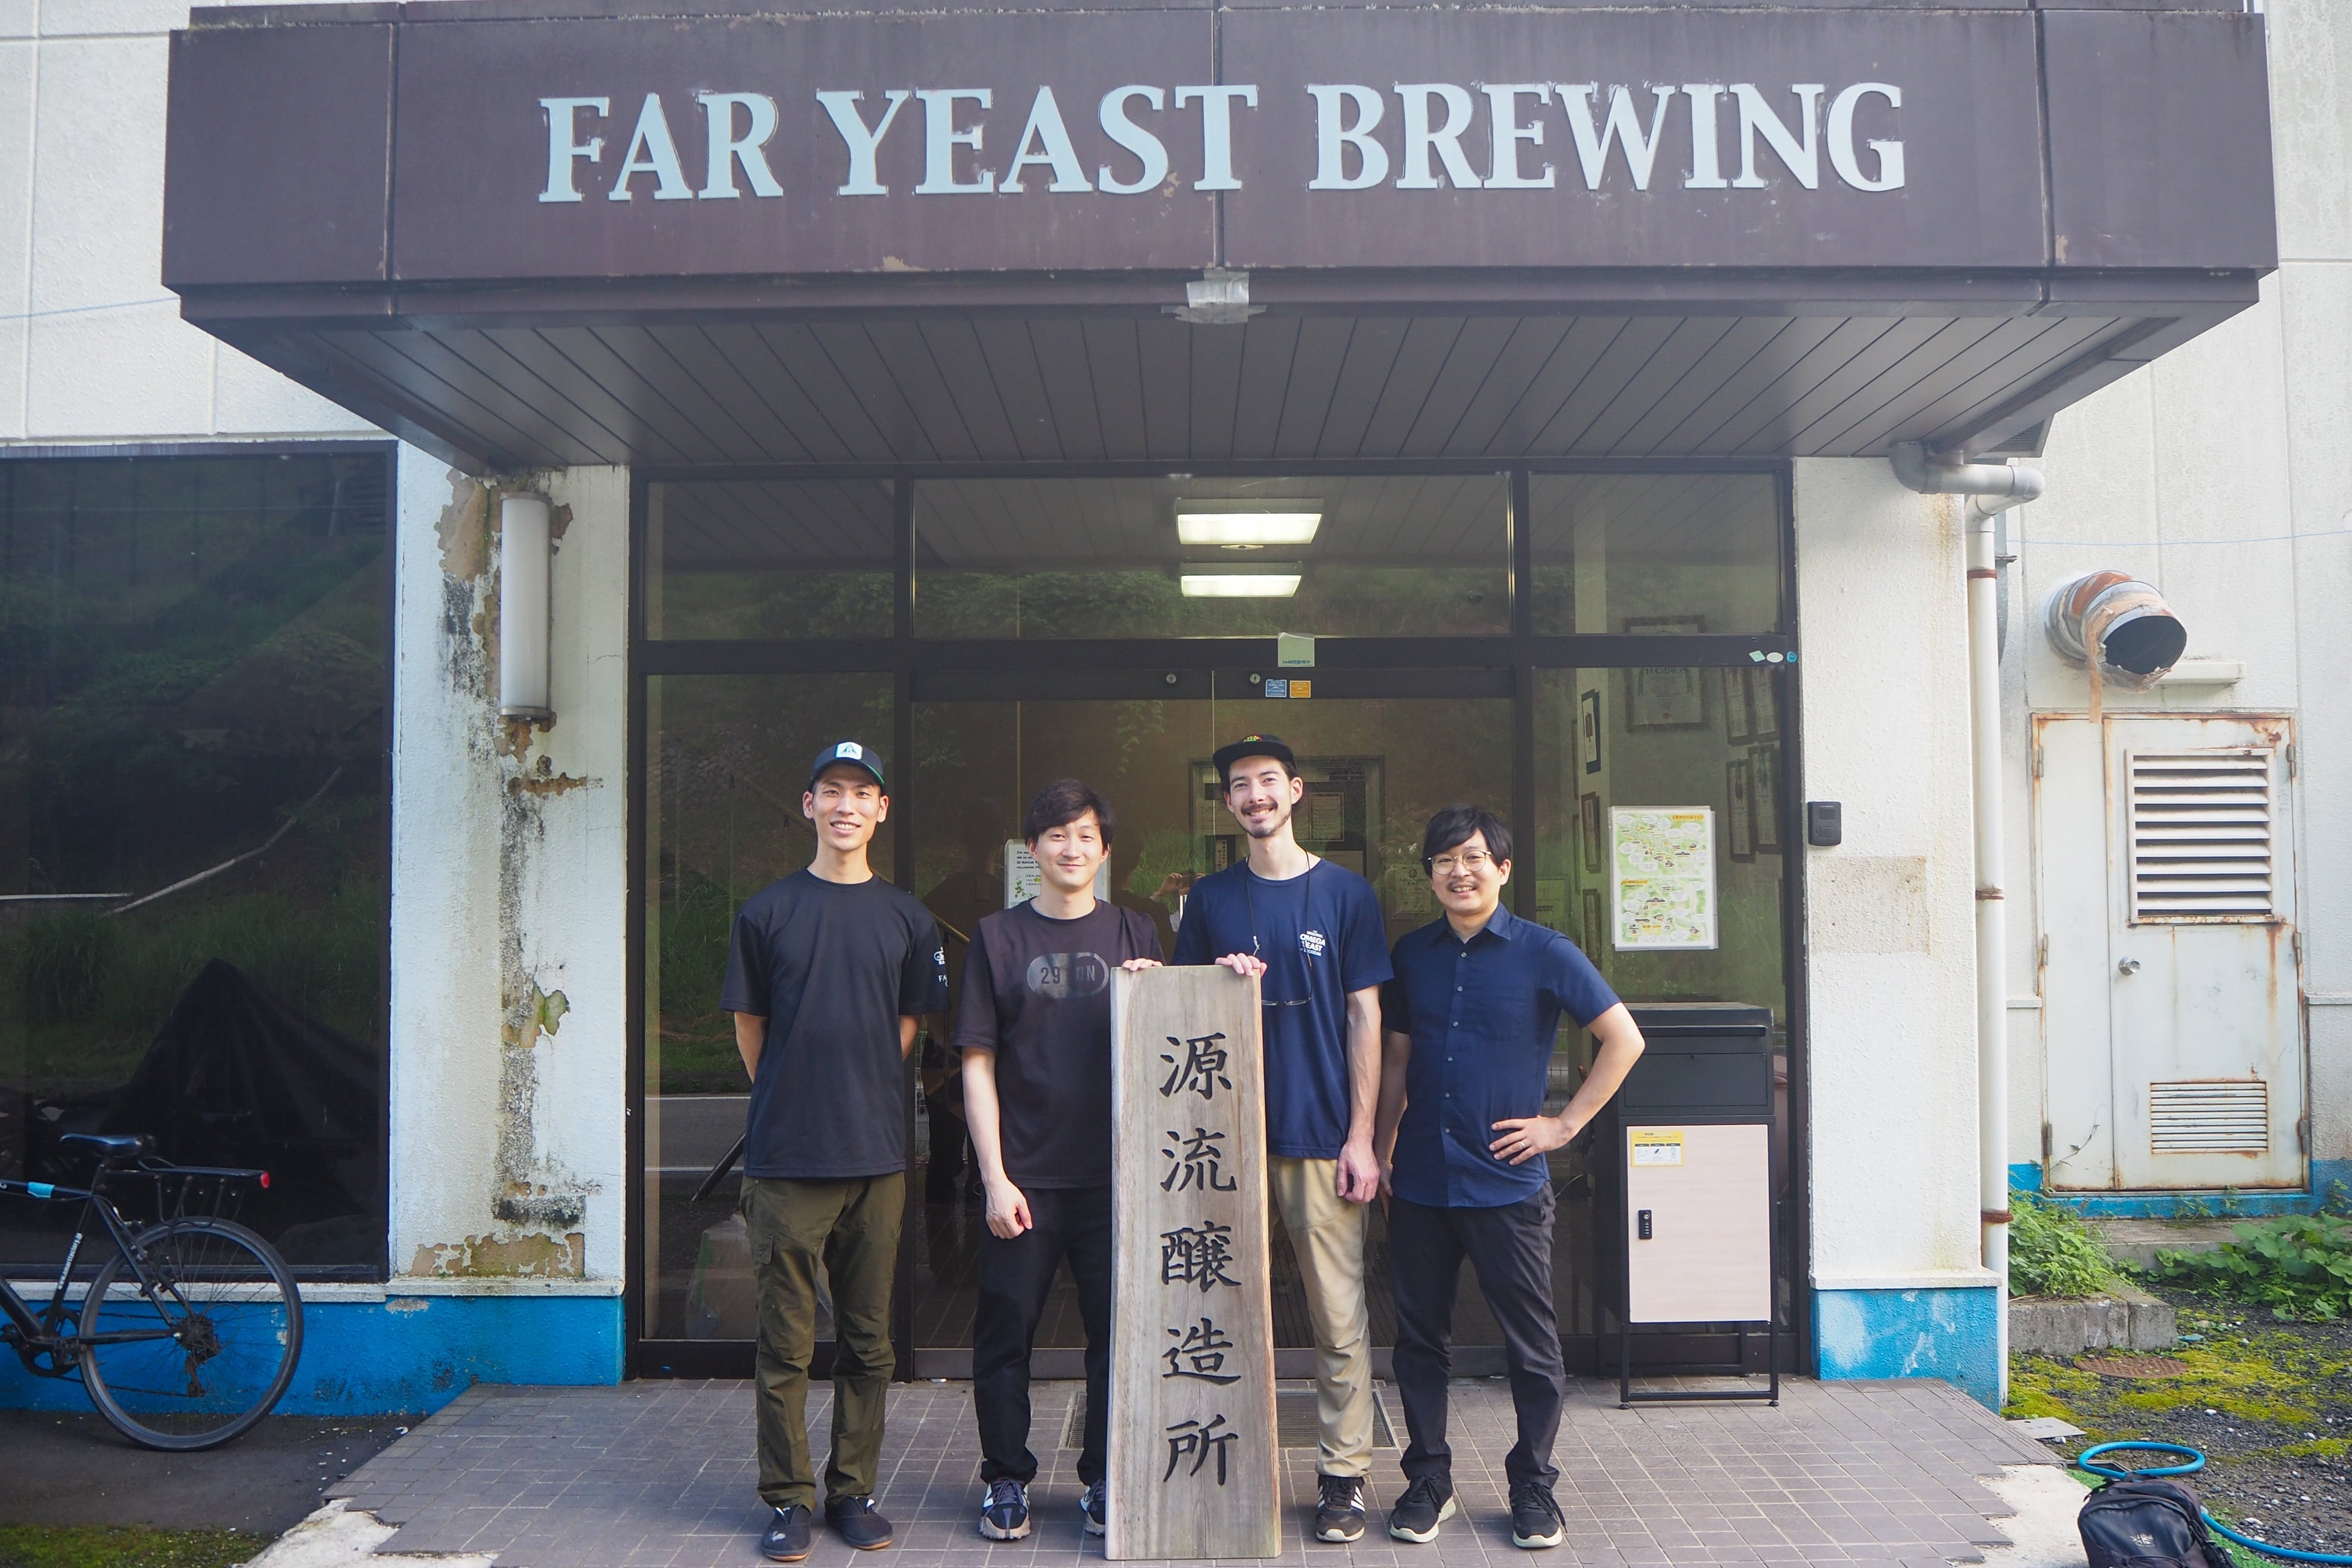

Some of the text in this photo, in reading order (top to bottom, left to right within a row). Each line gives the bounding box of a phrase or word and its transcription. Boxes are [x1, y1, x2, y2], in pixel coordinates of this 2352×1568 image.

[538, 82, 1906, 203] FAR YEAST BREWING
[1300, 933, 1326, 946] OMEGA
[1040, 967, 1061, 984] 29
[1159, 1031, 1243, 1486] 源流醸造所
